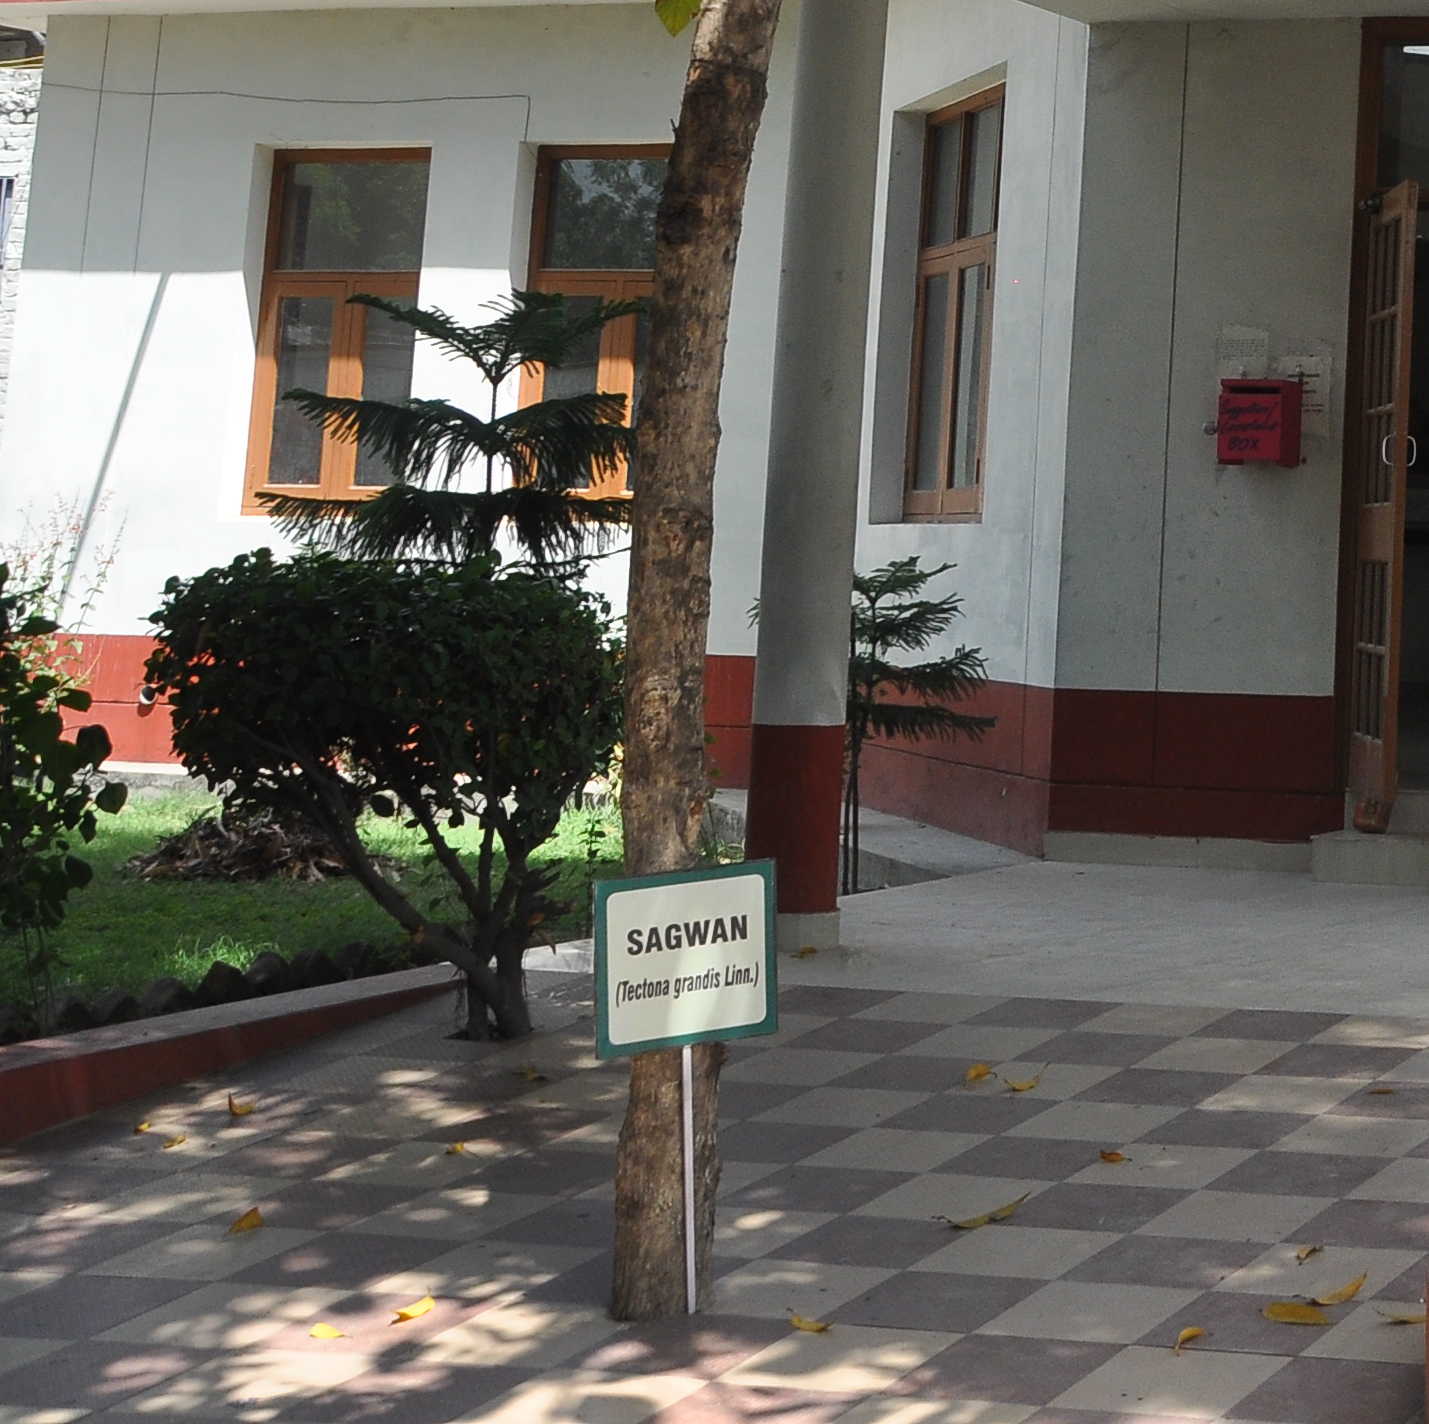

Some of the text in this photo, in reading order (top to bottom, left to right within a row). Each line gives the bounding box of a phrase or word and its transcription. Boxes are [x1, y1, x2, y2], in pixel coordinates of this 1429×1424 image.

[626, 914, 748, 956] SAGWAN
[615, 962, 760, 1008] (Tectona grandis Linn.)
